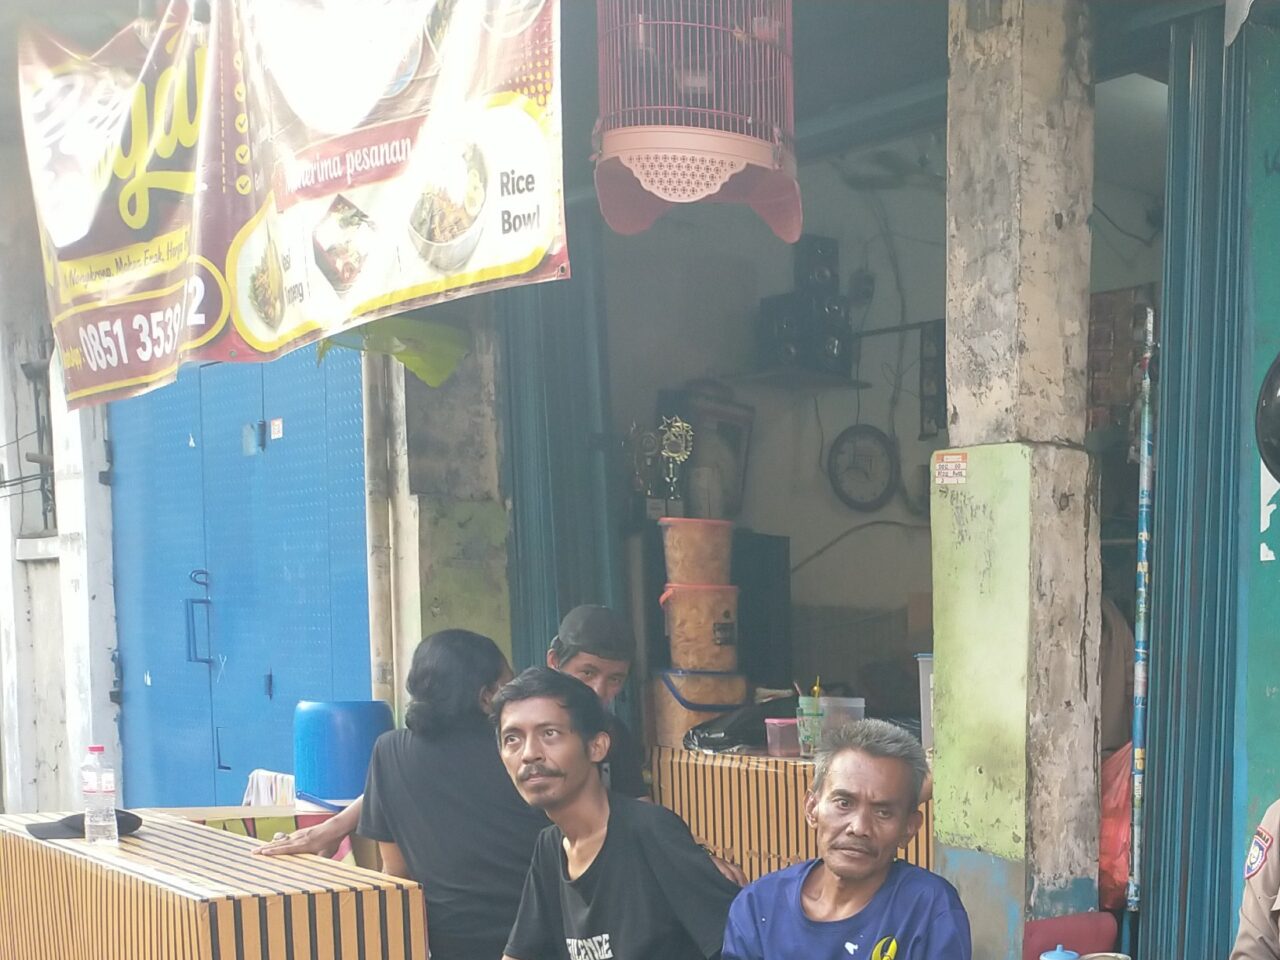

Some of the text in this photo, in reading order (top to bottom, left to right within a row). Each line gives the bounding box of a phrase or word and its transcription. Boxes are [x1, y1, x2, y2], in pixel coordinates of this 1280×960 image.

[346, 136, 413, 183] pesanan
[500, 169, 536, 197] Rice
[501, 203, 541, 236] Bowl
[78, 318, 129, 372] 0851
